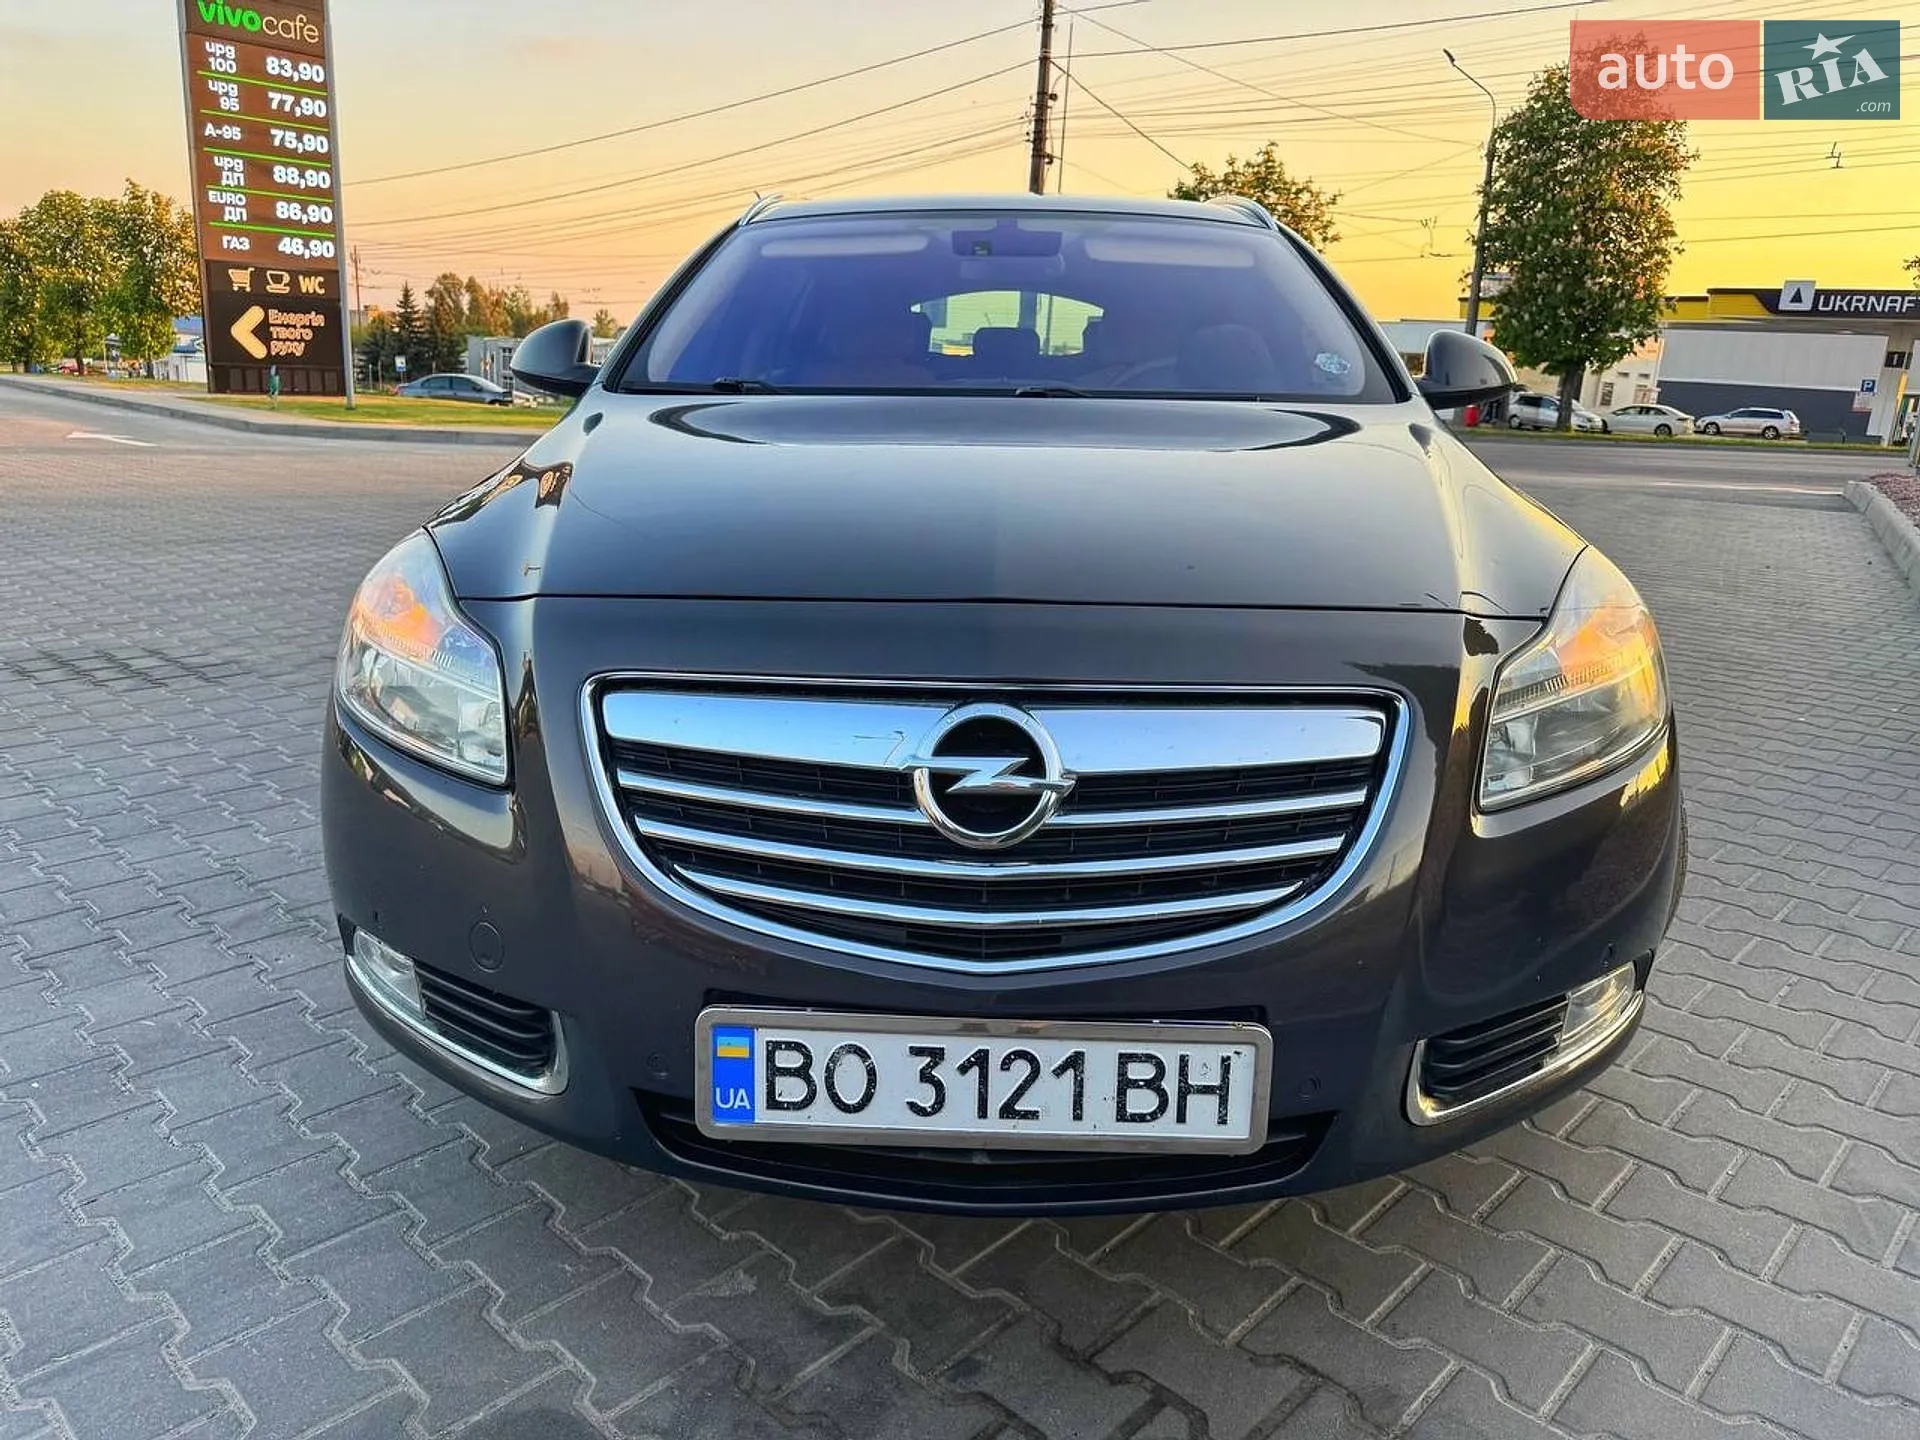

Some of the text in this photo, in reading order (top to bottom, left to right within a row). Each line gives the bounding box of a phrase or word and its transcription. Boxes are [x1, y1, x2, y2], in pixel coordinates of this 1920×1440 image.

[205, 41, 236, 60] upg
[208, 57, 237, 74] 100
[266, 56, 325, 83] 83,90
[208, 79, 239, 98] upg
[219, 96, 240, 111] 95
[268, 92, 327, 118] 77,90
[270, 128, 329, 154] 75,90
[213, 156, 244, 173] upg
[221, 171, 245, 187] ДП
[273, 165, 331, 189] 88,90
[208, 190, 246, 206] EURO
[224, 206, 248, 222] ДП
[275, 201, 333, 225] 86,90
[222, 235, 251, 251] ГАЗ
[278, 236, 336, 259] 46,90
[298, 274, 326, 295] WC
[1863, 380, 1873, 391] P
[765, 1039, 1232, 1126] BO 3121 BH
[715, 1087, 752, 1111] UA
